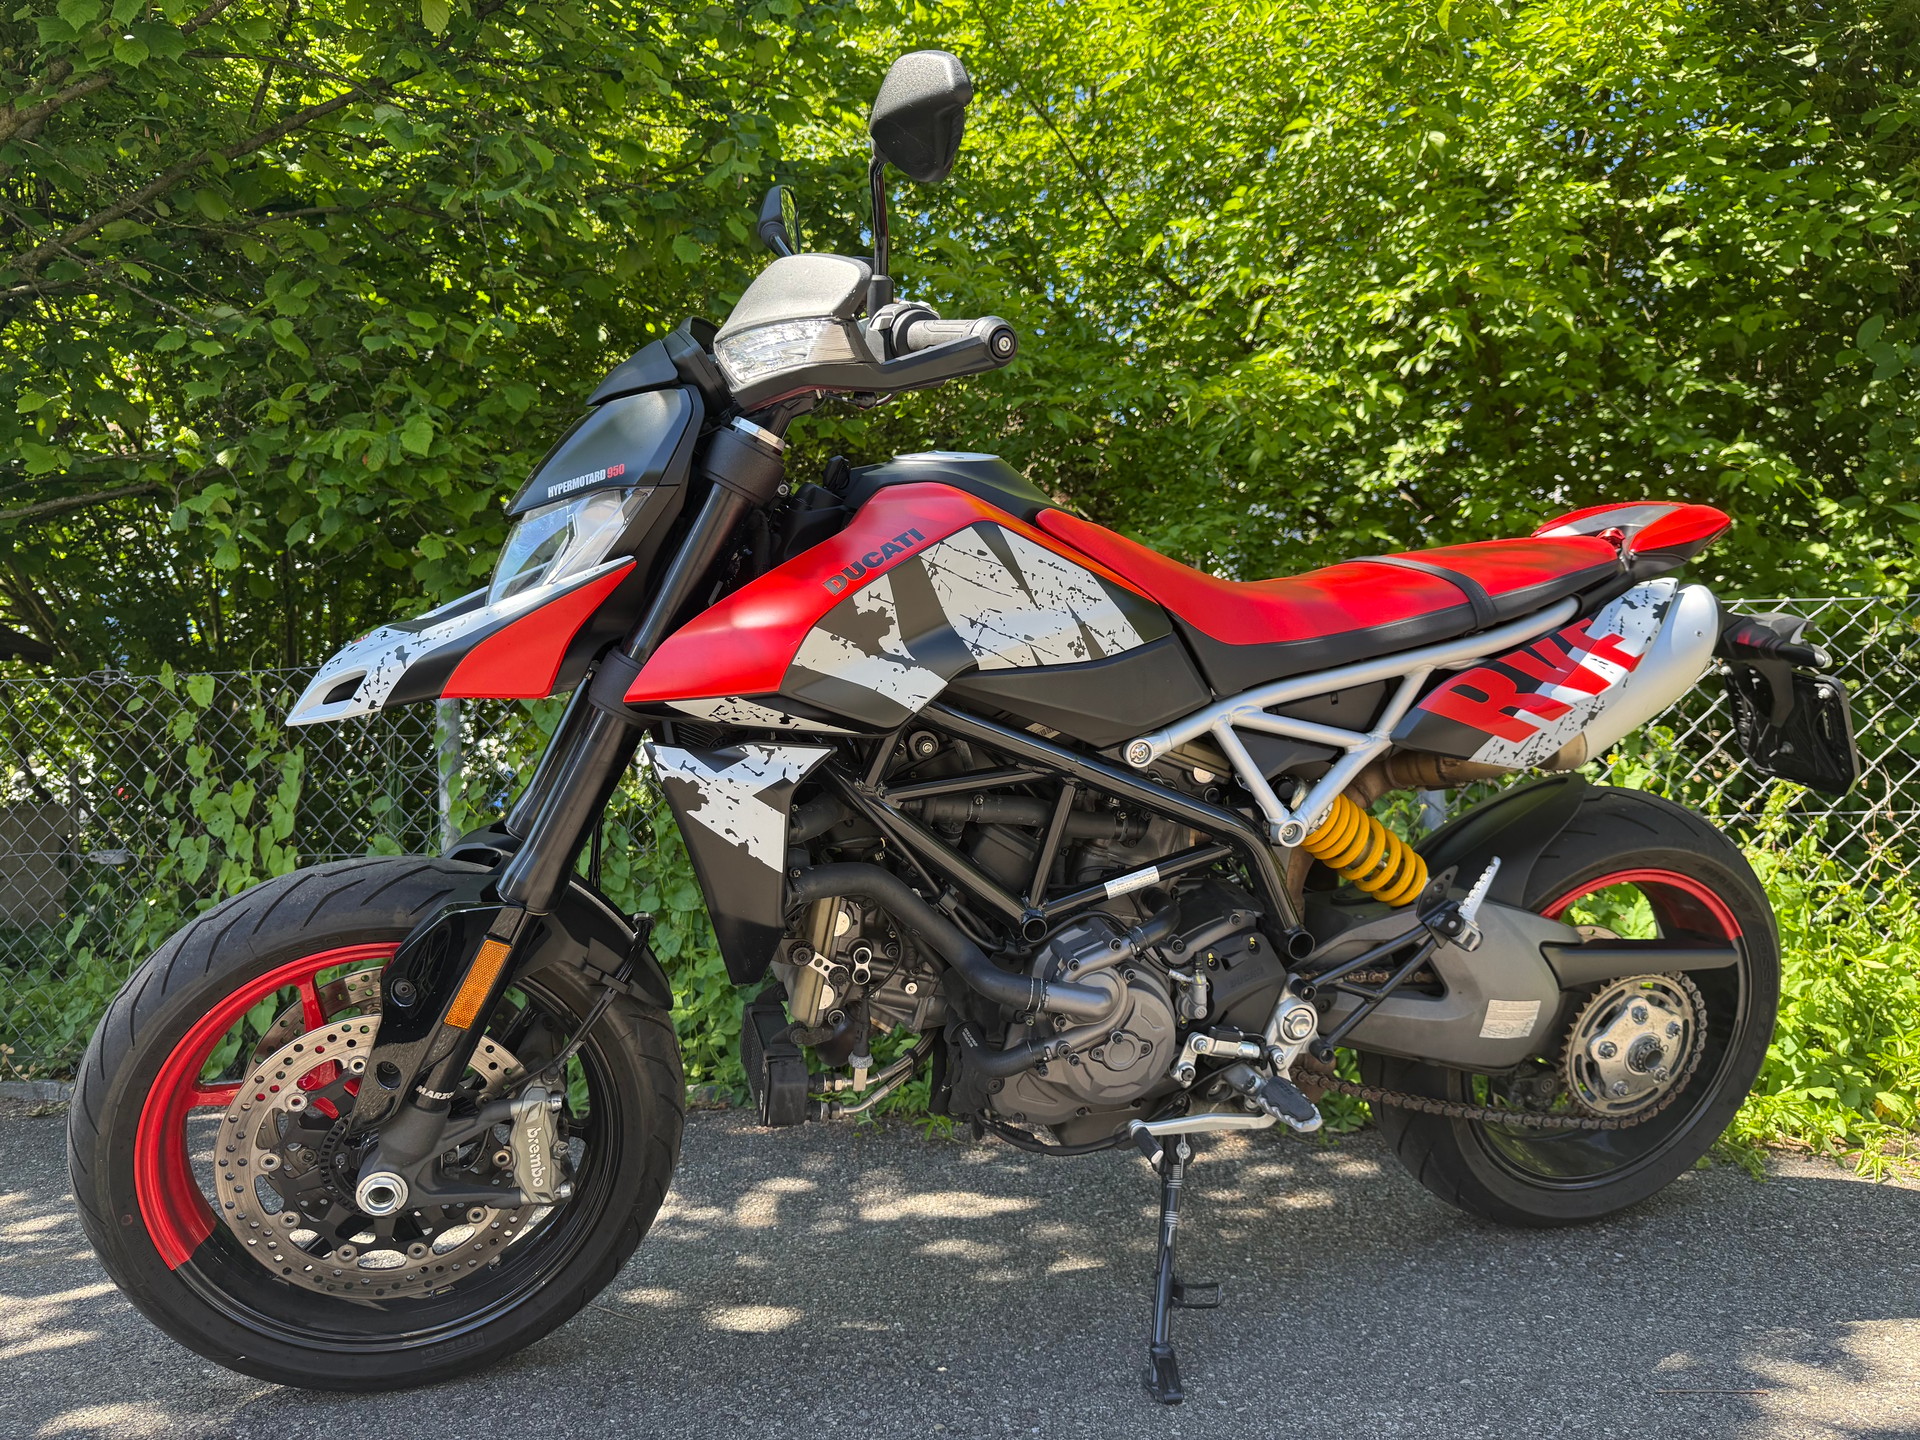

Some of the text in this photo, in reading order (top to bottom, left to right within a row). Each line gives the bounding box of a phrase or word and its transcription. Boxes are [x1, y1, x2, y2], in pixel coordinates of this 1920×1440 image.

[547, 463, 625, 499] HYPERMOTARD 950
[822, 528, 926, 596] DUCATI
[1417, 617, 1646, 744] RVE
[526, 1126, 546, 1188] brembo
